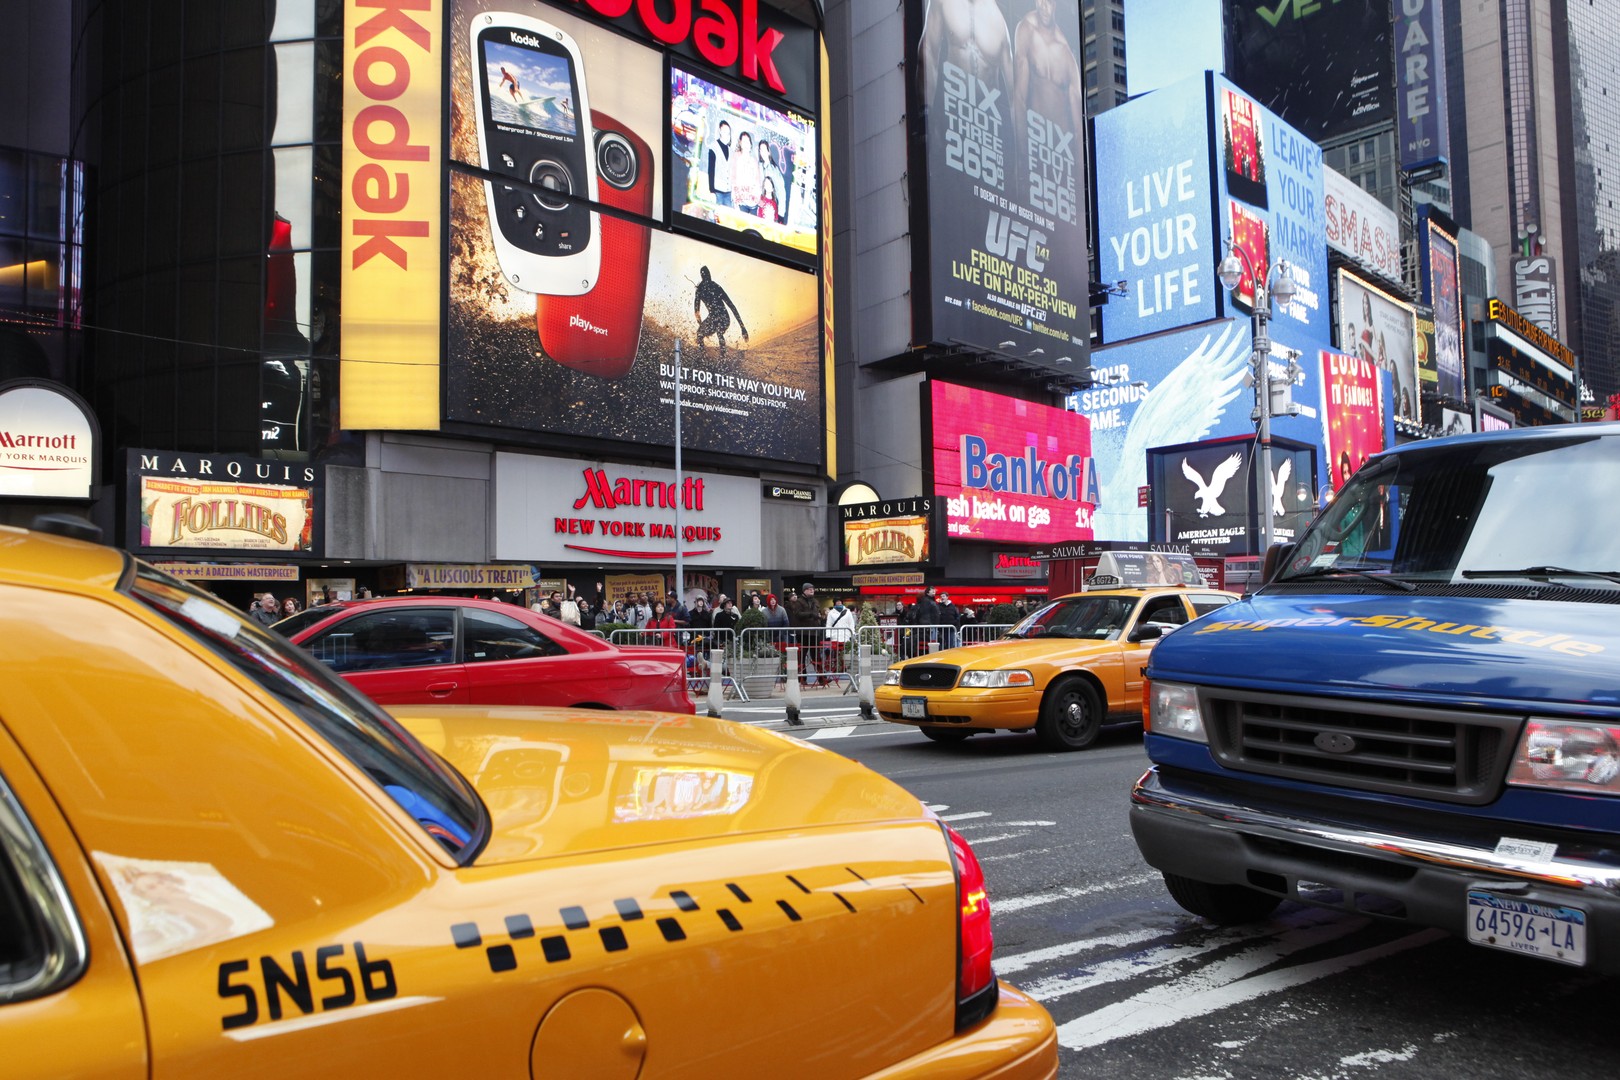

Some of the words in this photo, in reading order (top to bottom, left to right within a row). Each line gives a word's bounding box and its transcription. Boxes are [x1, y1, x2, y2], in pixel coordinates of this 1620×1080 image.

[510, 31, 540, 48] Kodak
[943, 61, 1002, 120] SIX
[944, 91, 1003, 137] FOOT
[352, 0, 431, 272] Kodak
[497, 124, 525, 134] Waterproof
[536, 131, 563, 141] Shockproof
[945, 111, 1003, 155] THREE
[1026, 108, 1074, 161] SIX
[1409, 138, 1431, 151] NYC
[945, 129, 998, 188] 265
[1028, 137, 1075, 177] FOOT
[1271, 122, 1314, 181] LEAVE
[1028, 156, 1075, 192] FIVE
[1126, 159, 1195, 219] LIVE
[974, 185, 979, 197] IT
[980, 187, 999, 206] DOESN'T
[999, 196, 1008, 209] GET
[1009, 201, 1018, 214] ANY
[1018, 206, 1033, 222] BIGGER
[1034, 213, 1045, 227] THAN
[1045, 219, 1055, 231] THIS
[1029, 171, 1071, 222] 256
[1278, 169, 1315, 222] YOUR
[558, 242, 572, 250] share
[985, 210, 1048, 272] UFC
[1035, 245, 1050, 261] 141
[1110, 212, 1198, 272] YOUR
[1276, 211, 1316, 263] MARK
[1325, 194, 1399, 277] SMASH
[823, 153, 833, 358] Kodak
[971, 248, 1014, 280] FRIDAY
[952, 260, 980, 285] LIVE
[984, 272, 1001, 293] ON
[1004, 280, 1077, 319] PAY-PER-VIEW
[987, 293, 997, 302] ALSO
[997, 297, 1015, 309] AVAILABLE
[1021, 303, 1037, 318] UFC
[1137, 263, 1201, 318] LIFE
[569, 314, 590, 331] play
[593, 325, 608, 336] sport
[971, 299, 1023, 326] facebook.com/UFC
[1550, 284, 1558, 332] Chocolate
[660, 364, 689, 380] BULT
[692, 370, 713, 384] FOR
[714, 373, 735, 388] THE
[736, 377, 760, 392] WAY
[761, 382, 782, 397] YOU
[784, 387, 807, 401] PLAY.
[1090, 364, 1129, 388] YOUR
[660, 380, 707, 396] WATRPROOF.
[708, 388, 750, 403] SHOCKPROOF.
[751, 396, 789, 409] DUSTPROOF.
[1083, 381, 1149, 411] SECONDS
[39, 455, 87, 463] MARQUIS
[141, 454, 314, 482] MARQUIS
[962, 435, 1048, 497] Bank
[1050, 455, 1080, 500] of
[180, 484, 200, 495] PETERS
[212, 485, 236, 494] MAXWELL
[169, 496, 288, 545] FOLLIES
[844, 499, 930, 518] MARQUIS
[973, 496, 1007, 521] back
[1009, 503, 1025, 522] on
[1028, 505, 1050, 528] gas
[554, 517, 595, 534] NEW
[599, 520, 645, 537] YORK
[650, 523, 722, 543] MAQUIS
[857, 530, 915, 564] FOLLIES
[1178, 528, 1218, 540] AMERICAN
[1219, 526, 1245, 537] EAGLE
[212, 567, 246, 577] DAZZLING
[433, 569, 484, 584] LUSCIOUS
[1510, 941, 1540, 952] LIVERY
